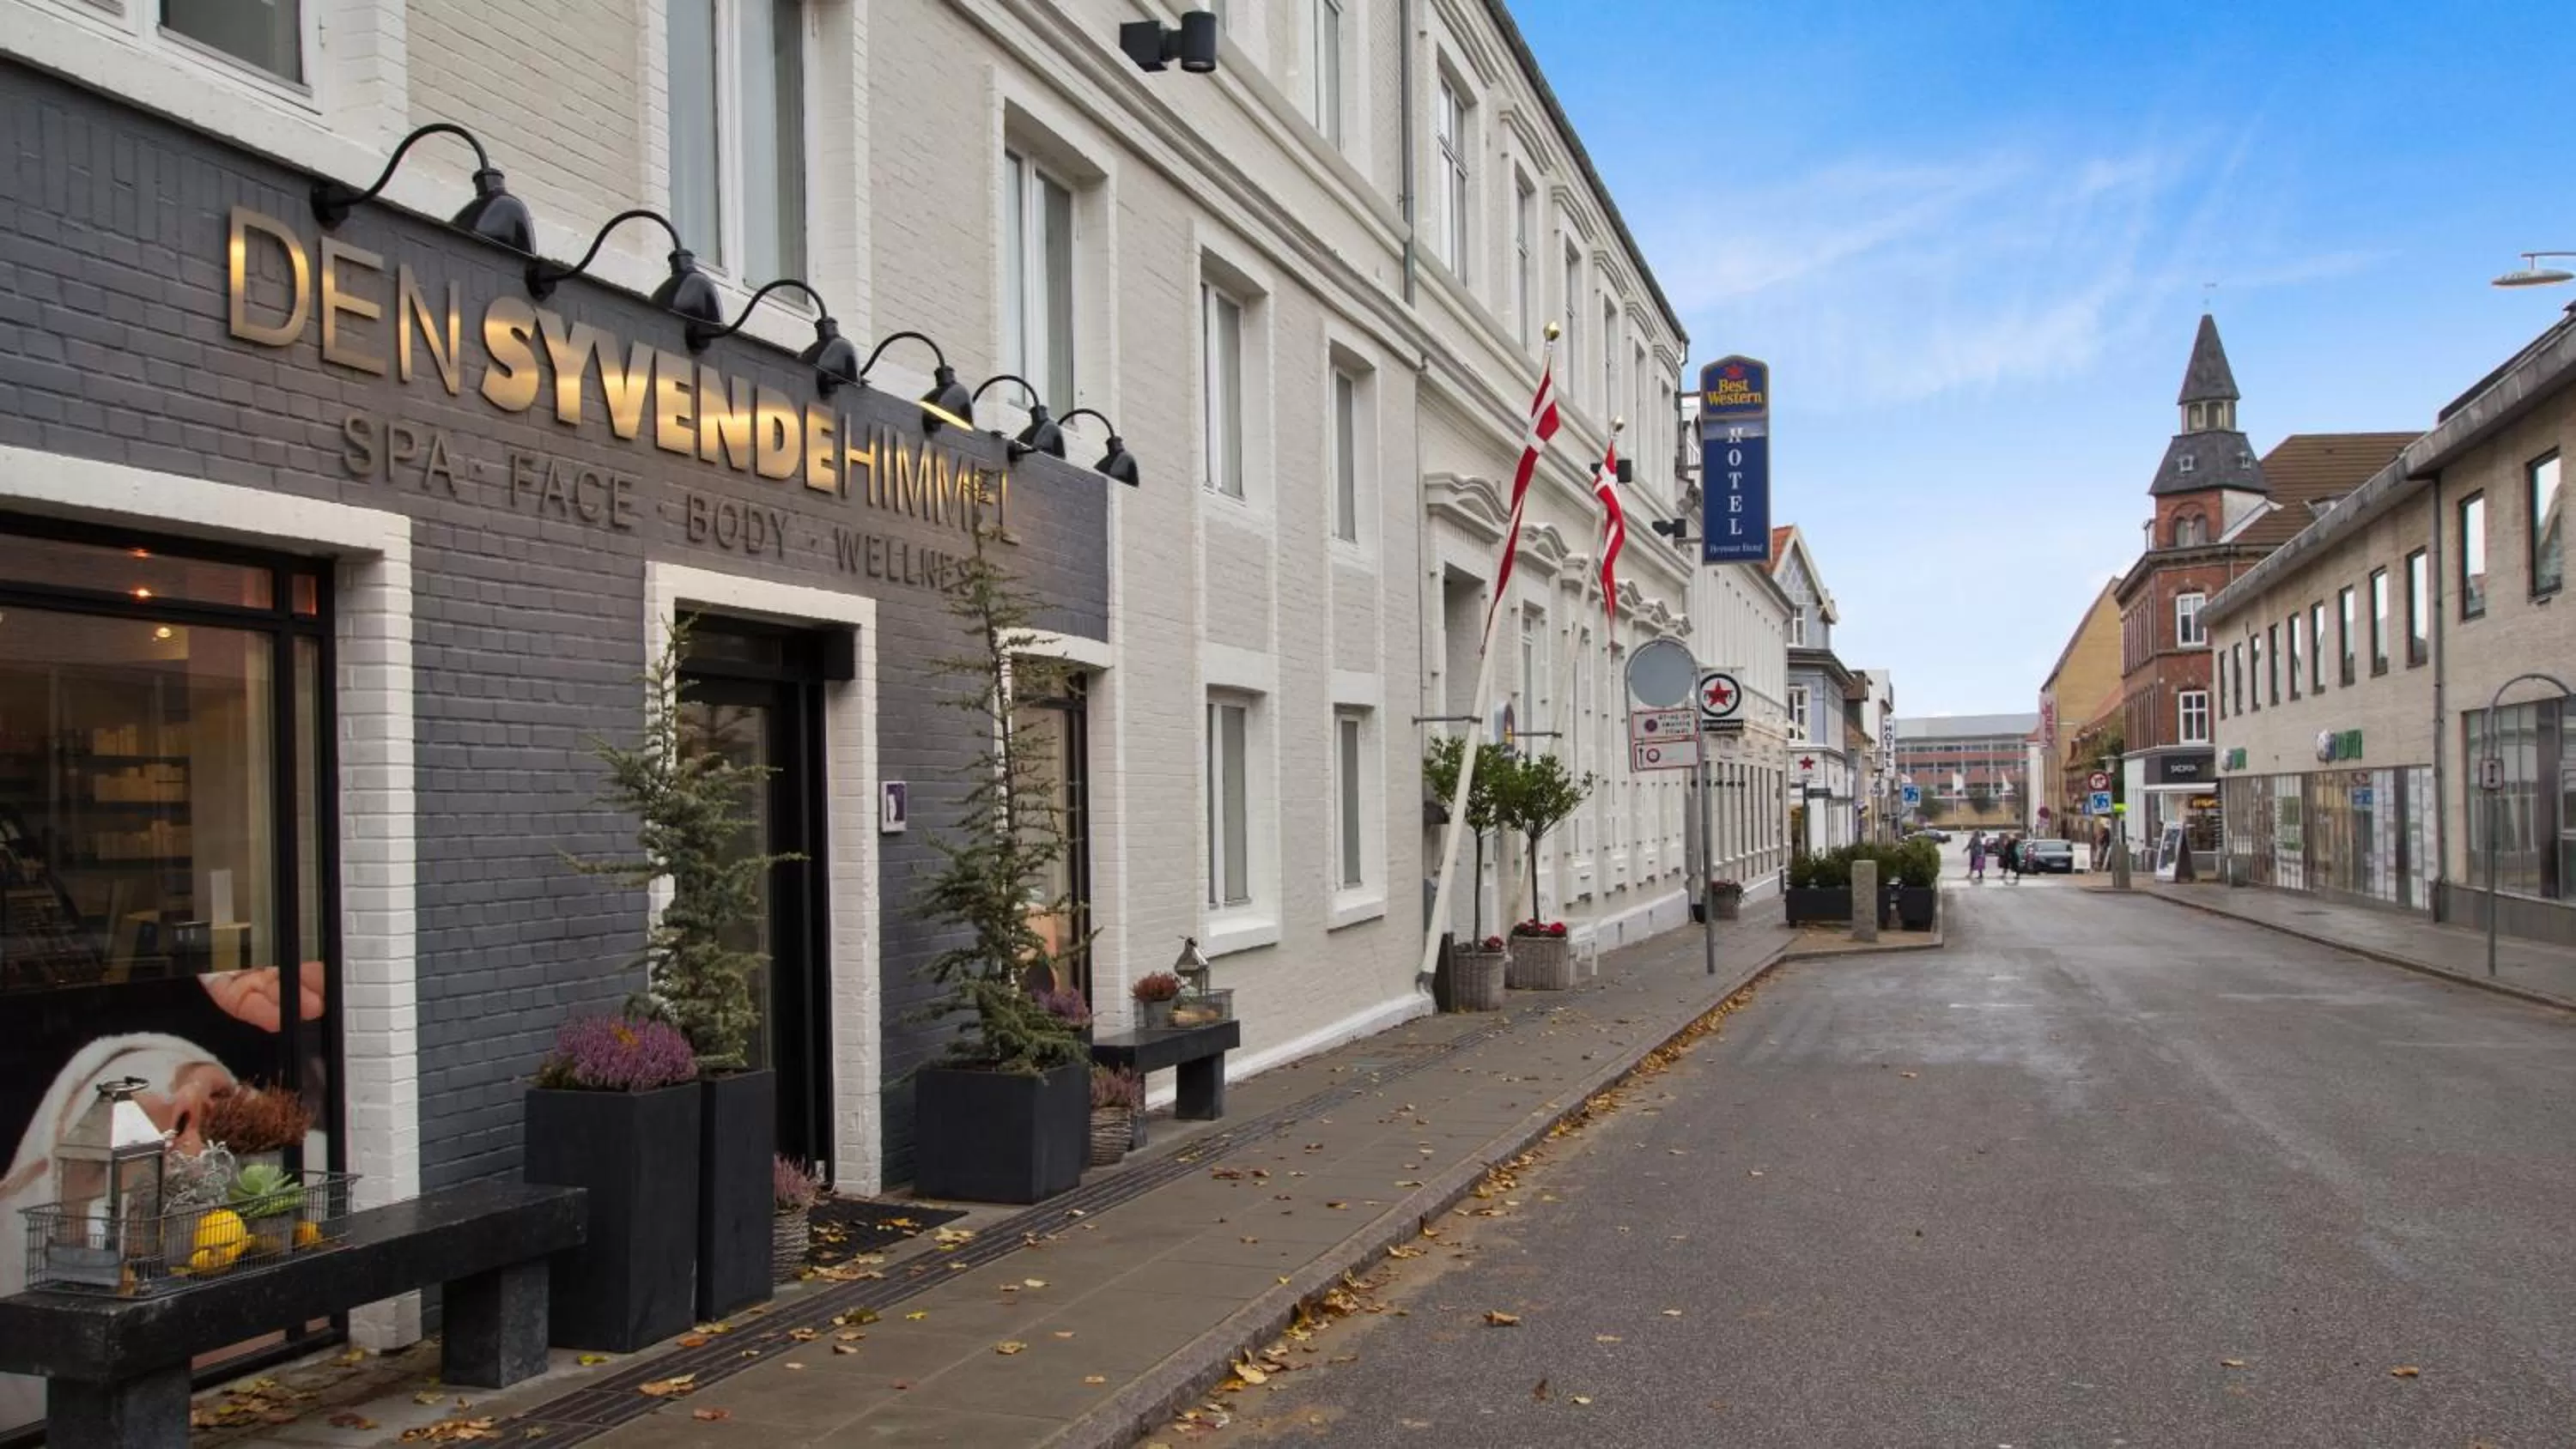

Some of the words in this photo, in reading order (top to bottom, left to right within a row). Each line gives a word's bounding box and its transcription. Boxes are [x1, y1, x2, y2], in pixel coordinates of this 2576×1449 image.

[1707, 391, 1763, 405] Western
[1718, 379, 1749, 392] Best
[343, 409, 459, 498] SPA
[511, 452, 633, 528] FACE
[686, 492, 789, 559] BODY
[1727, 427, 1743, 536] HOTEL
